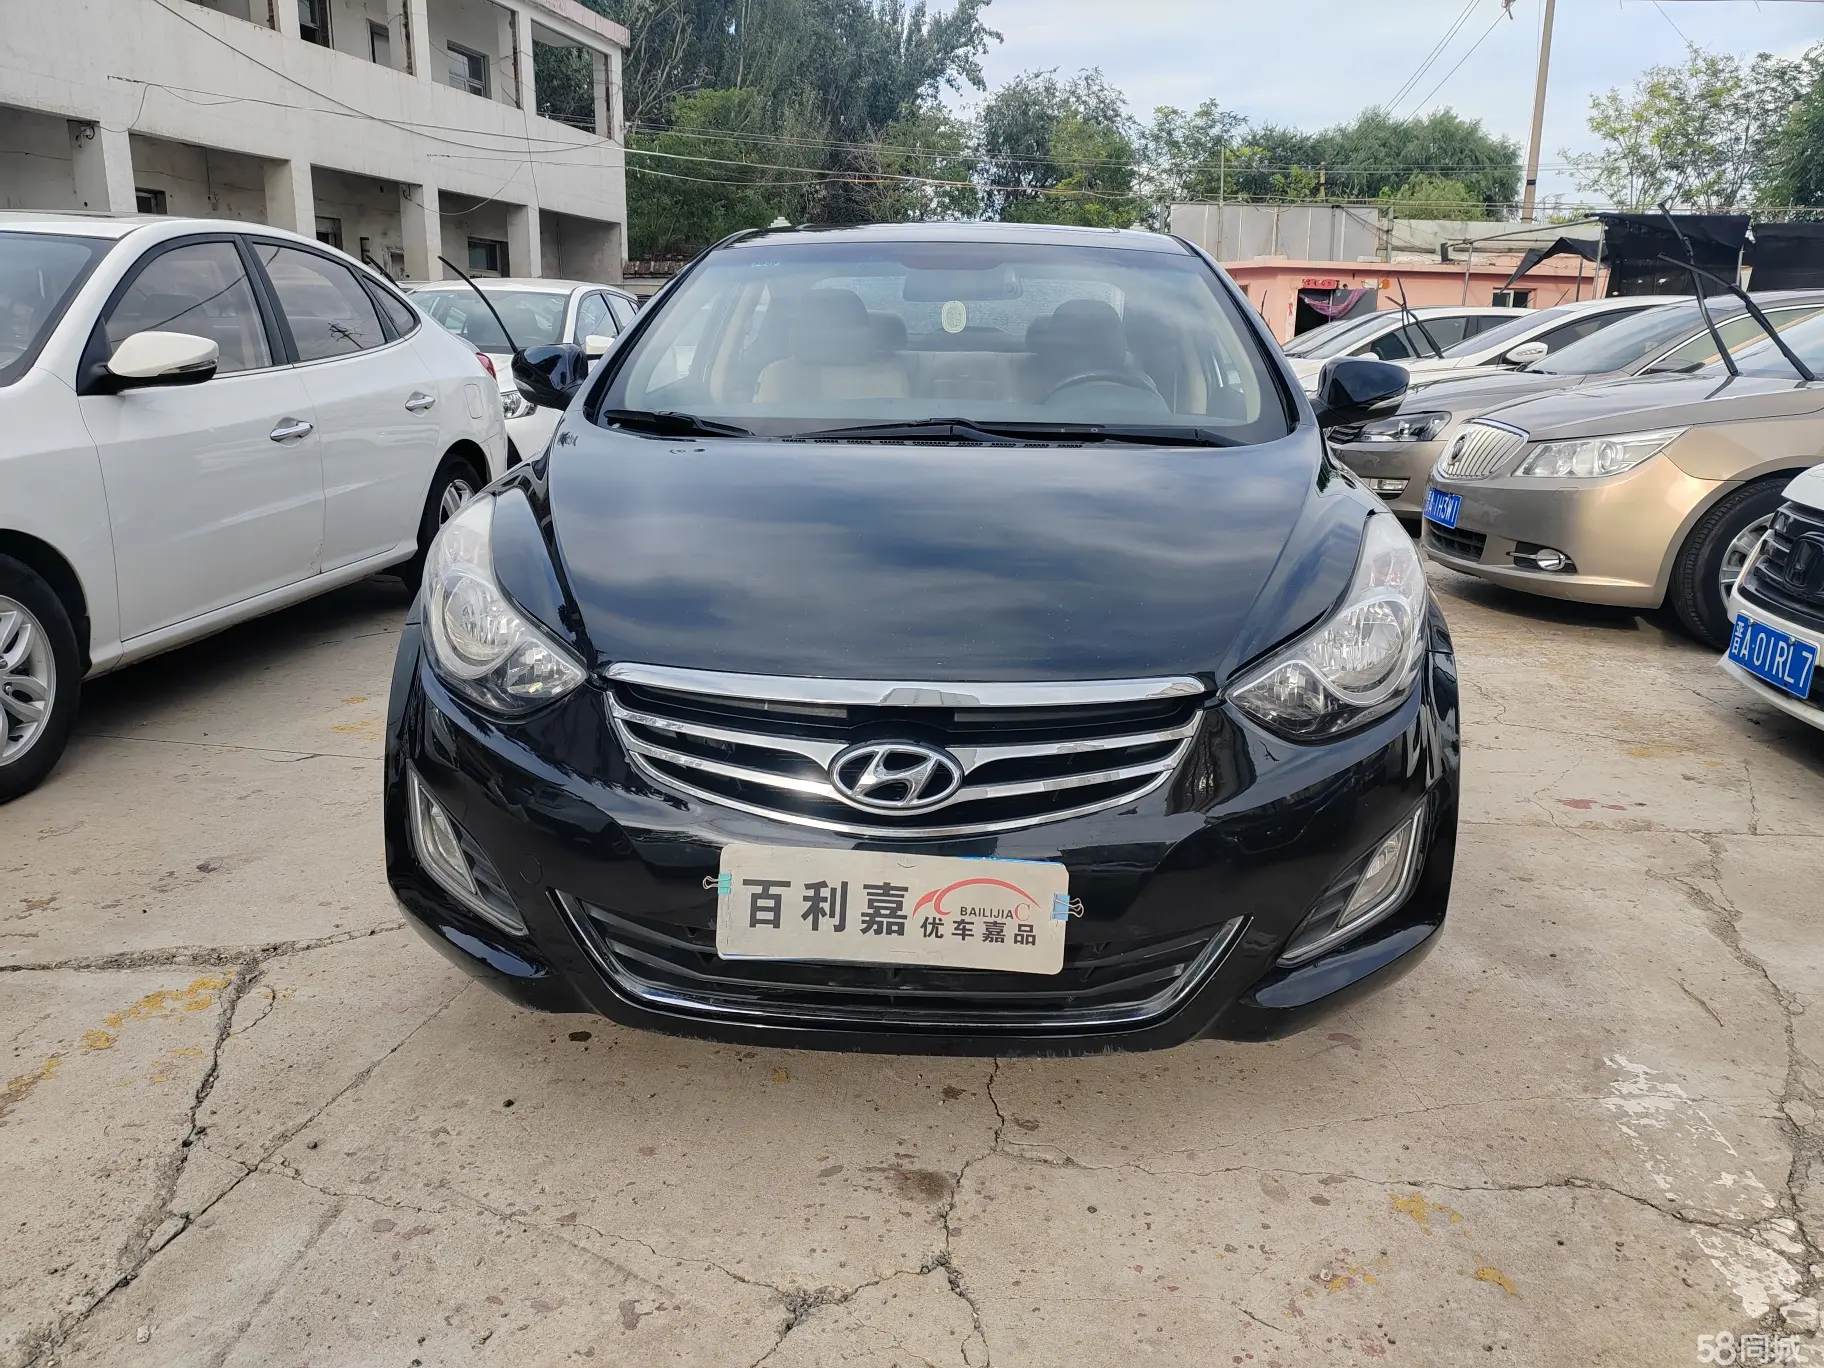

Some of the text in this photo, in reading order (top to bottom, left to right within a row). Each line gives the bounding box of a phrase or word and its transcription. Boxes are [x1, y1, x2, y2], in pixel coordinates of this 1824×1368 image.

[742, 878, 909, 936] 百利嘉
[920, 916, 1037, 946] 优车嘉品
